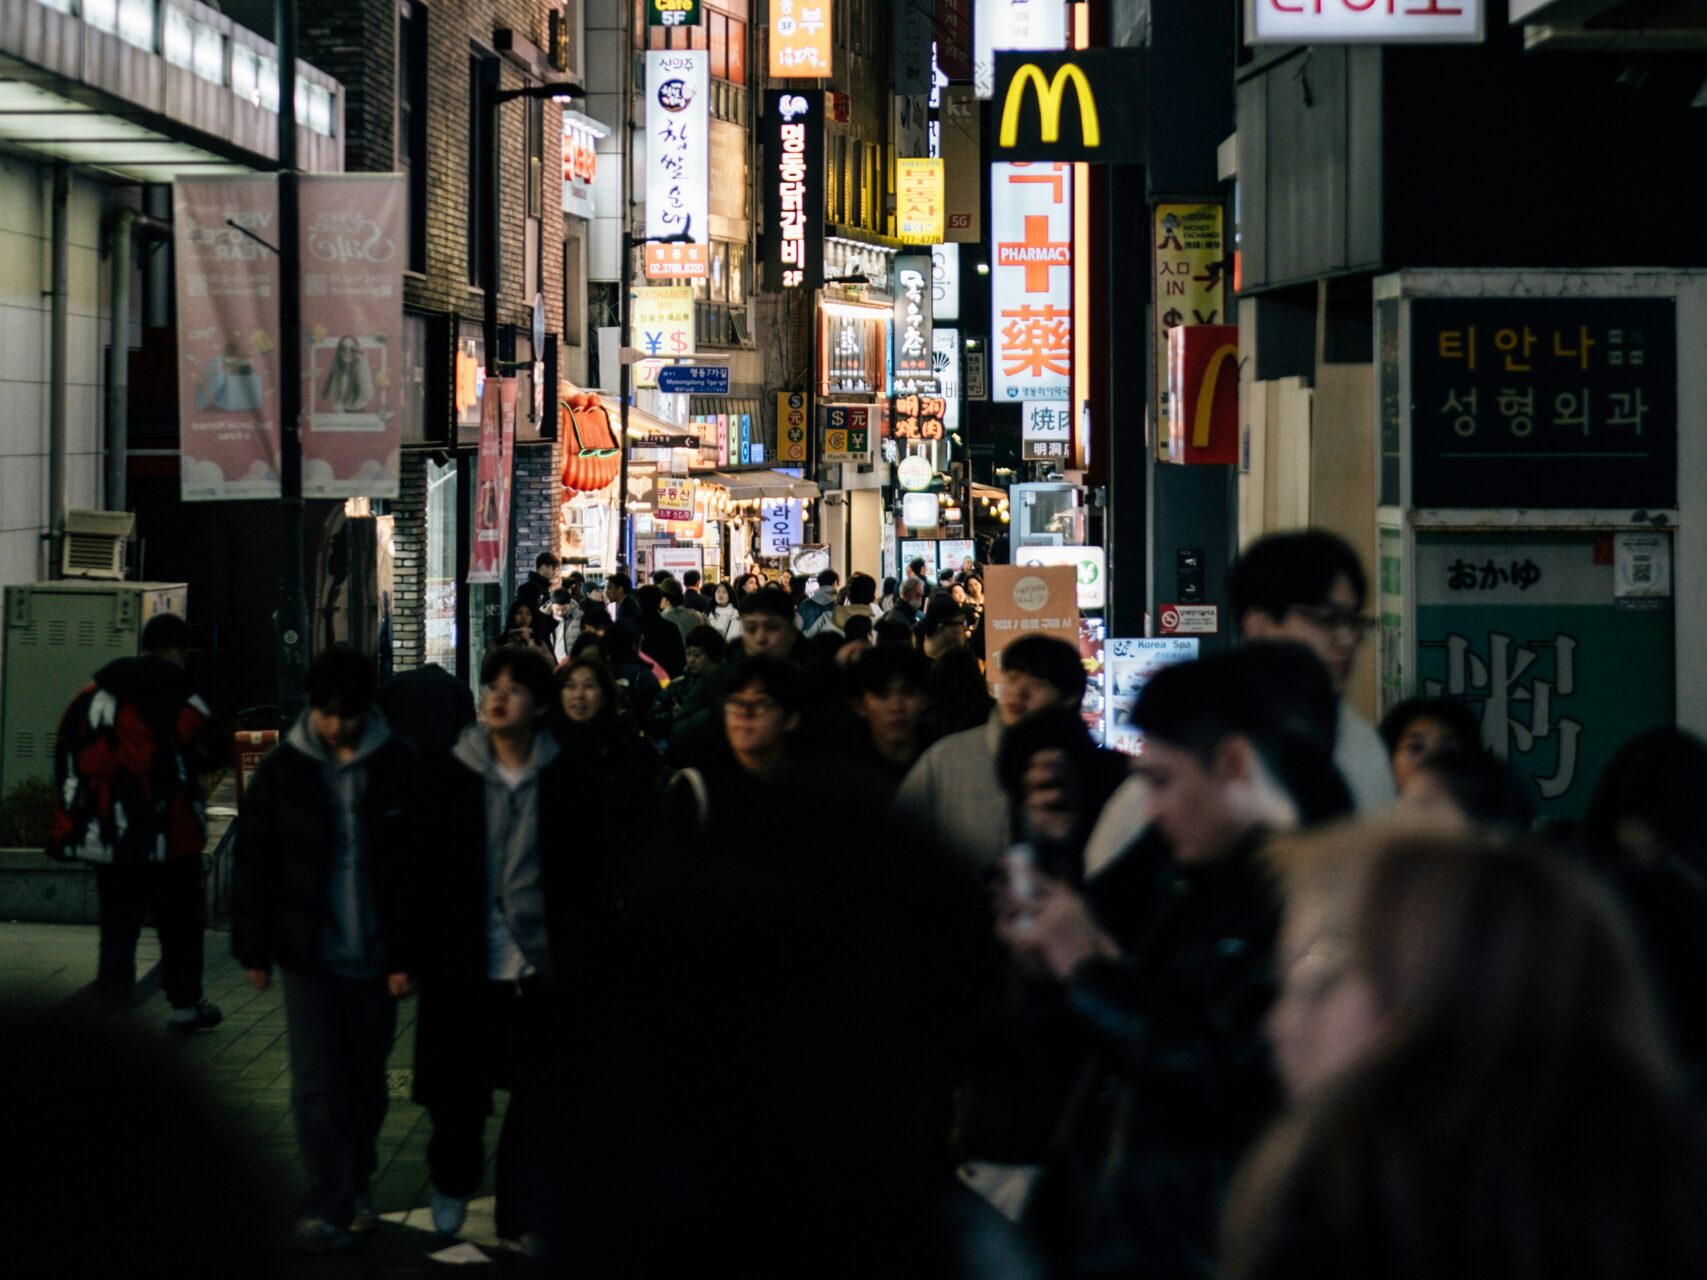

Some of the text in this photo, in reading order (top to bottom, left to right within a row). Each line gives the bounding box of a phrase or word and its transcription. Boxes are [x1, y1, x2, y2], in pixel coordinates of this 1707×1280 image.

[661, 10, 687, 25] 5F
[780, 20, 794, 32] 3F
[946, 96, 972, 118] kt
[779, 122, 807, 270] 명동닭갈비
[904, 169, 940, 221] 부동산
[951, 215, 968, 227] 5G
[1160, 261, 1189, 276] 入口
[783, 270, 803, 287] 2F
[1166, 280, 1185, 296] IN
[1438, 324, 1597, 372] 티안나
[1440, 386, 1652, 437] 성형외과
[1446, 558, 1541, 592] おかゆ
[1137, 639, 1192, 650] Korea Spa
